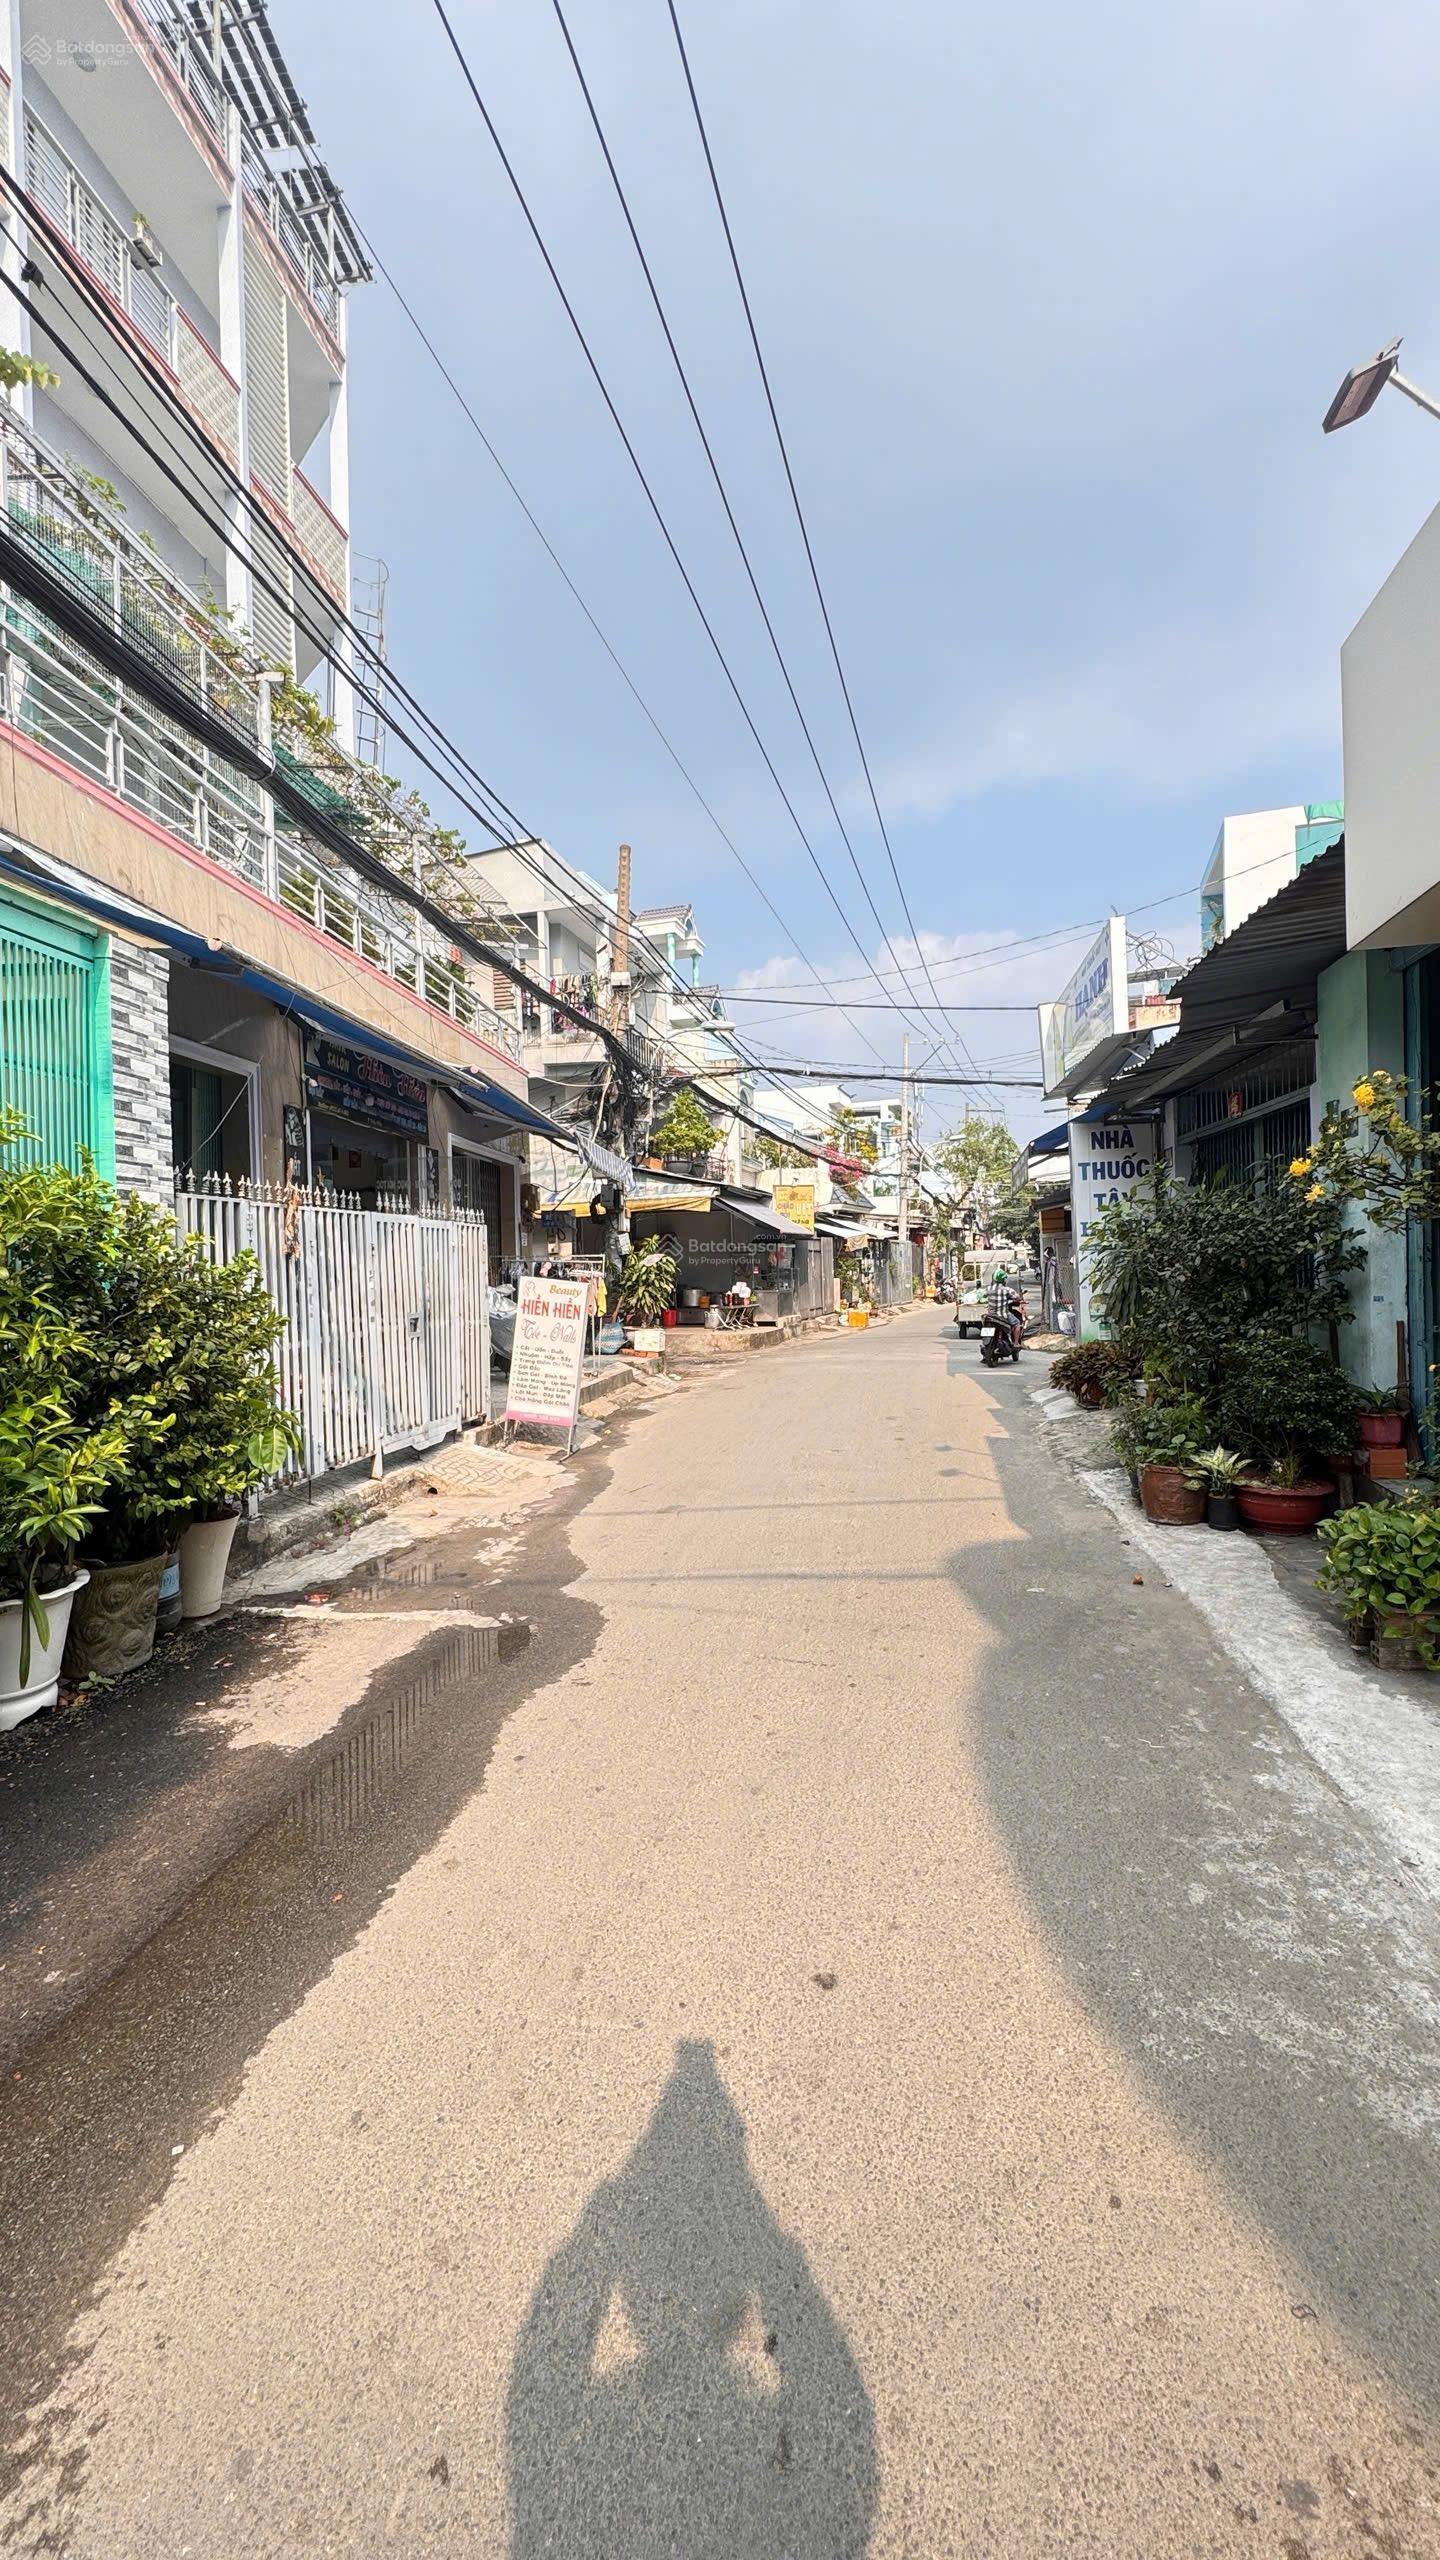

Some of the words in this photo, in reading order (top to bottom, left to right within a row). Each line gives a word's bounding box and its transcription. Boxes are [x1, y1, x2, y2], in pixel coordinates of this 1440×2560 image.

[327, 1051, 350, 1073] SALON
[1090, 1125, 1135, 1151] NHÀ
[1078, 1152, 1151, 1181] THUỐC
[550, 1284, 583, 1298] Beauty
